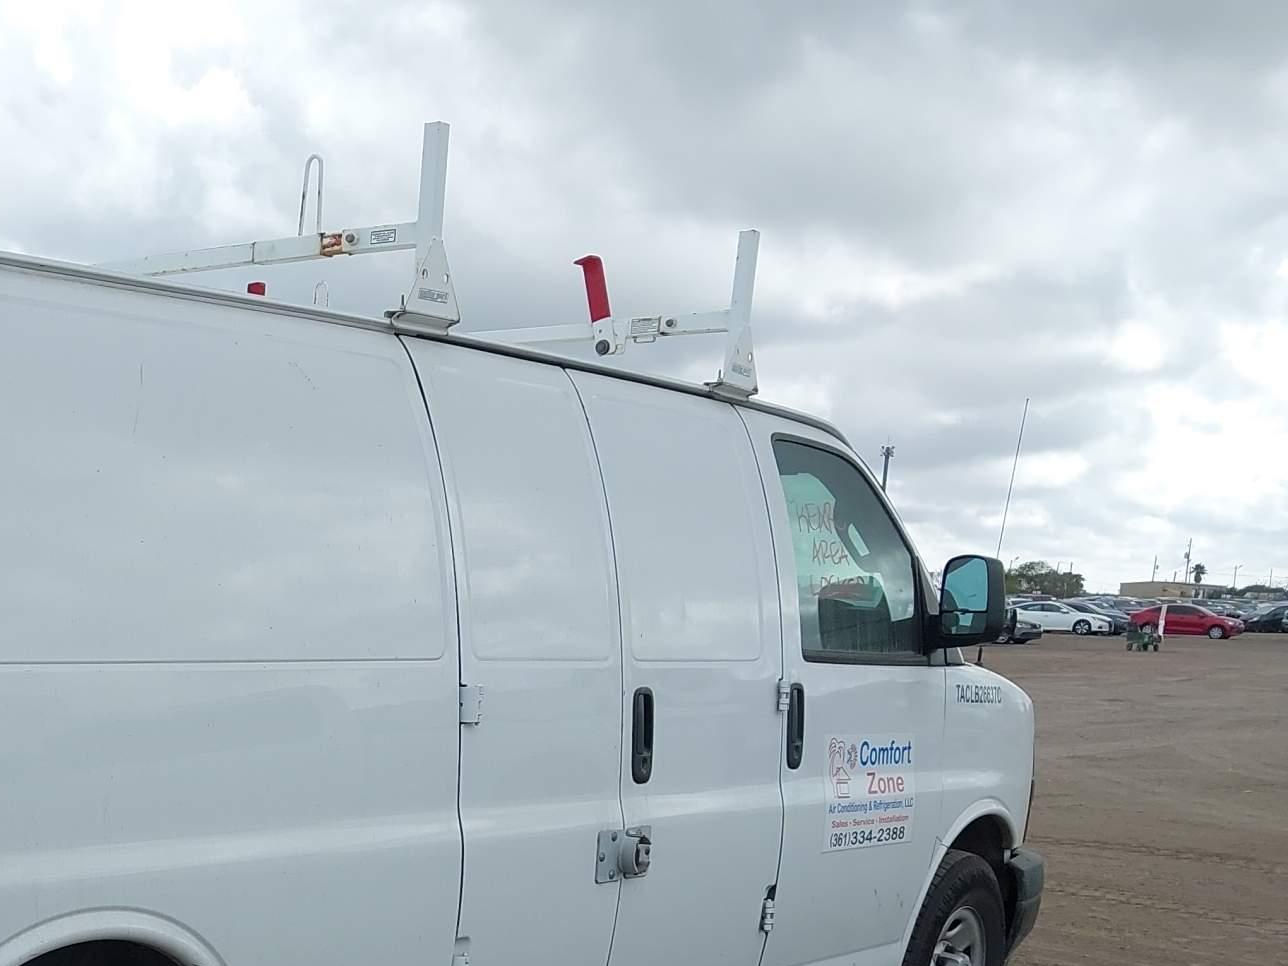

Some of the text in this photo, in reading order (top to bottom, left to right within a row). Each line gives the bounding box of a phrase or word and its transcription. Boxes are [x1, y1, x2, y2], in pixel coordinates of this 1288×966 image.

[813, 537, 850, 566] AREA
[860, 740, 912, 766] Comfort
[866, 772, 905, 795] Zone
[837, 802, 868, 814] Conditioning
[904, 797, 914, 807] LLC
[832, 820, 848, 828] Sales
